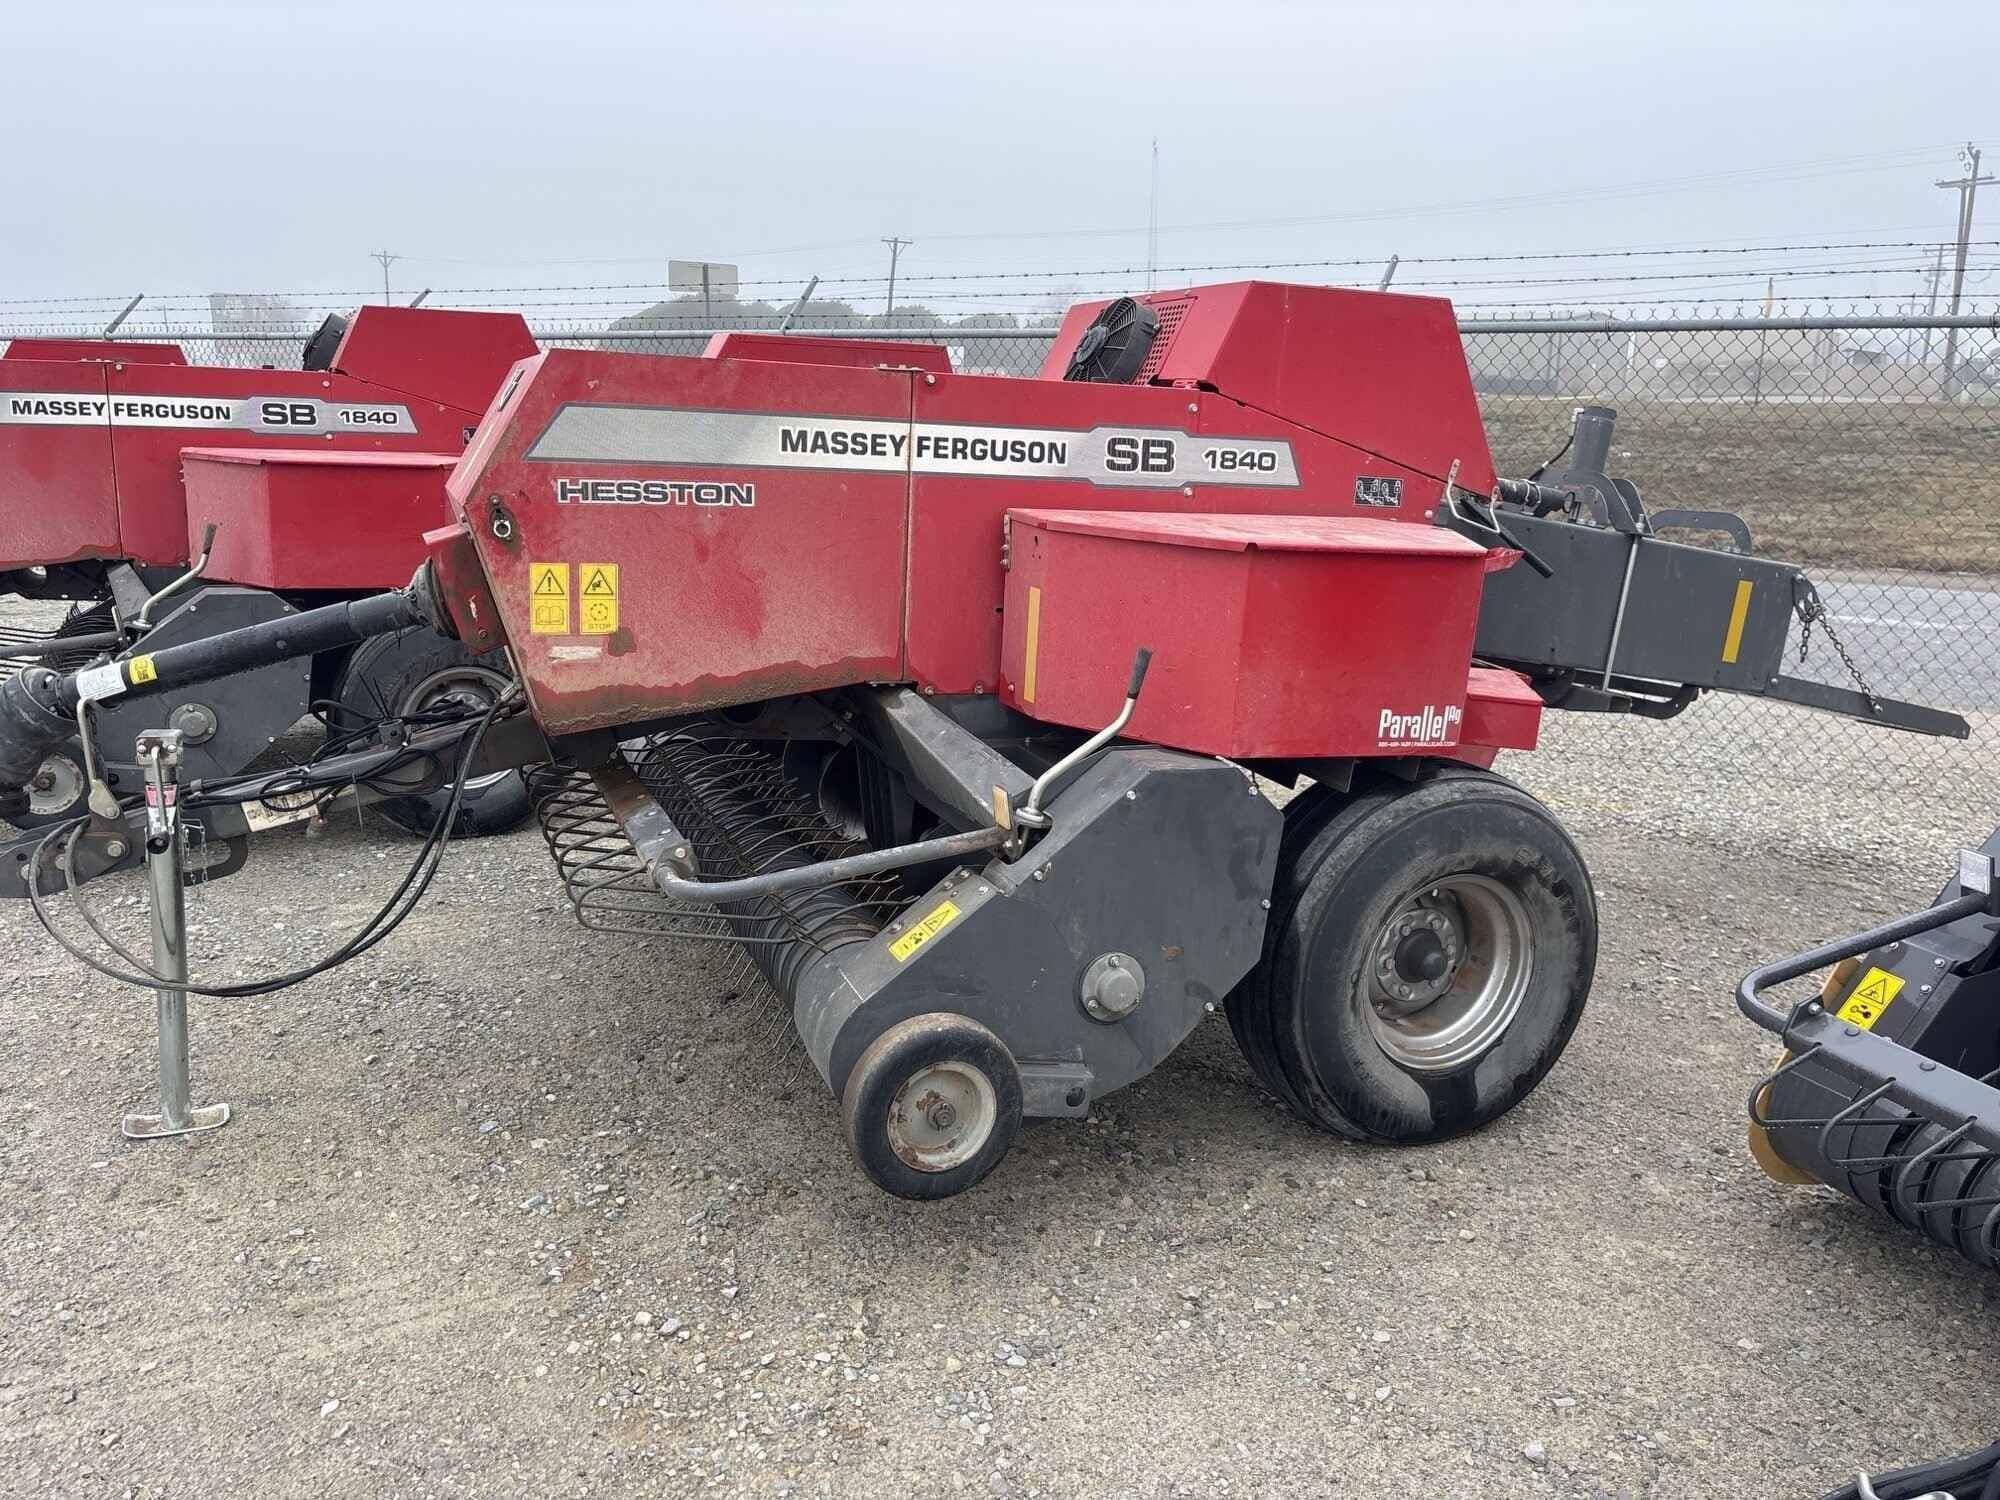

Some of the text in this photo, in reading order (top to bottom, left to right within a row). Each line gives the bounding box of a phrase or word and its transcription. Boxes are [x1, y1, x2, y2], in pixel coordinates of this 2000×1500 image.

[12, 400, 398, 425] MASSEY FERGUSON SB 1840
[781, 429, 1276, 473] MASSEY FERGUSON SB 1840
[559, 481, 753, 504] HESSTON
[1378, 705, 1462, 742] Parallel Ag
